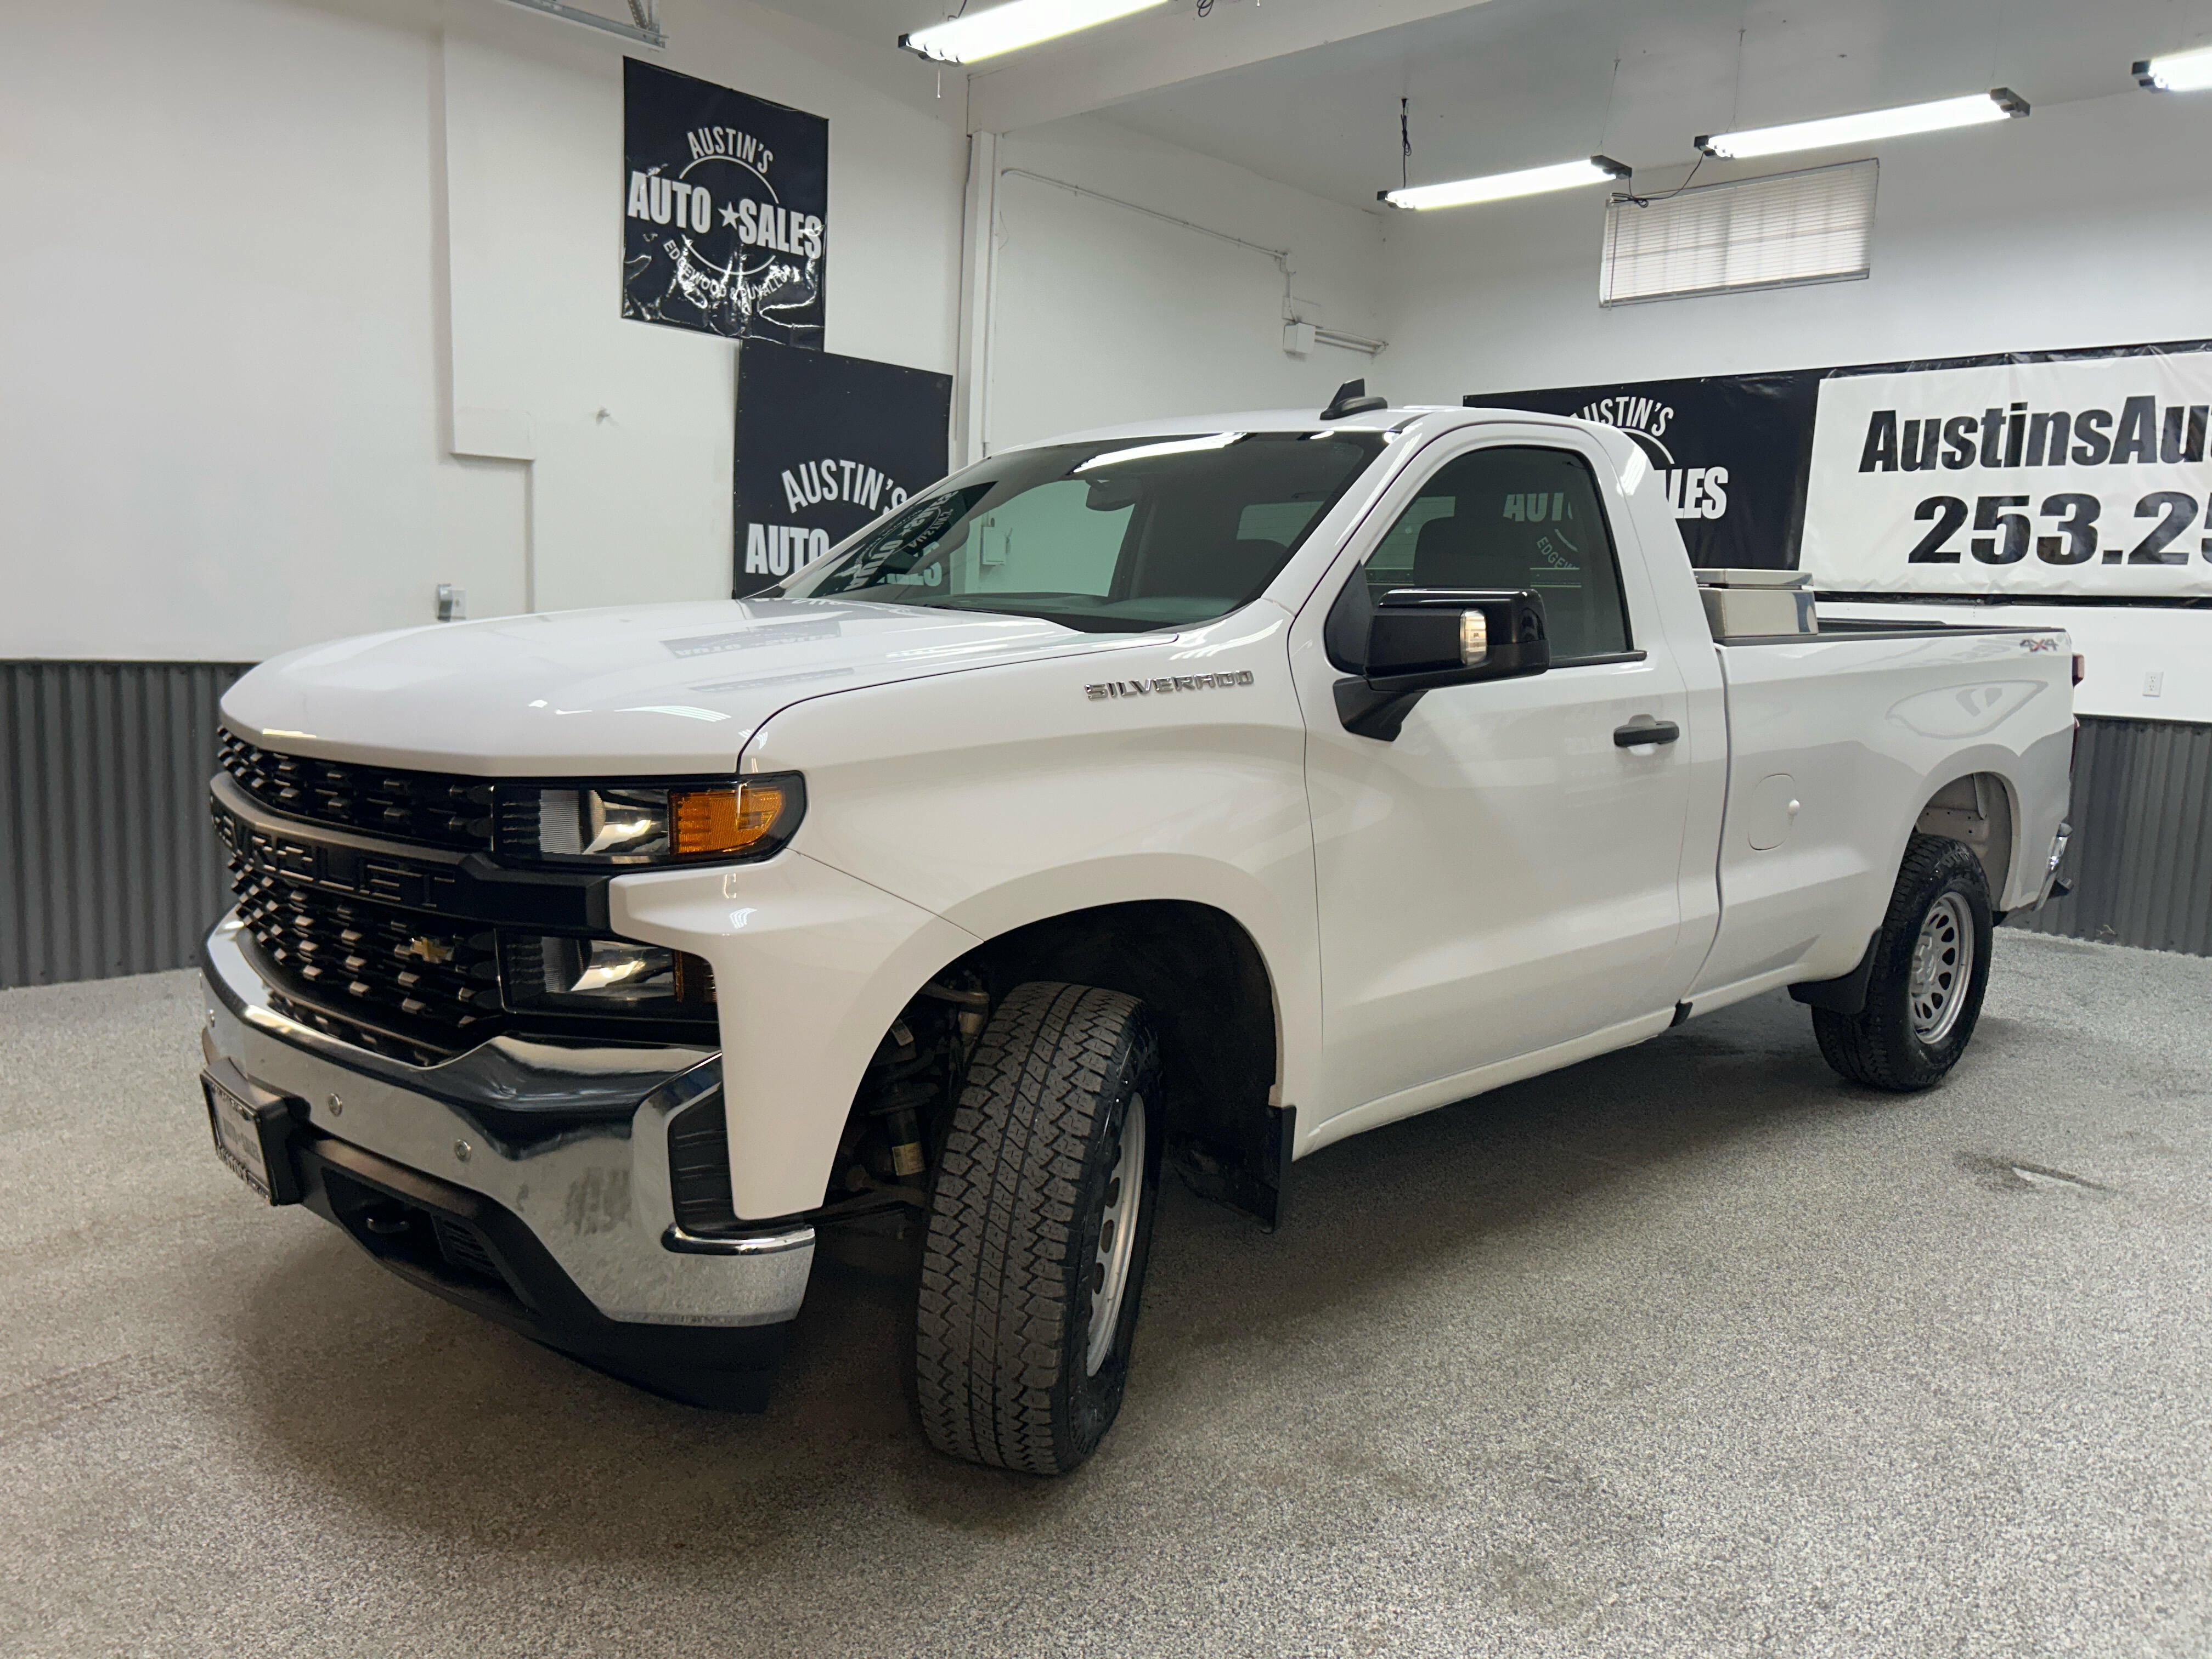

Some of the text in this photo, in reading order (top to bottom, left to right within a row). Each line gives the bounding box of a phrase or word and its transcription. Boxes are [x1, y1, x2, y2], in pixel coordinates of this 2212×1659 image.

[687, 127, 774, 174] AUSTIN'S
[628, 171, 823, 259] AUTO SALES
[663, 239, 727, 298] EDGEWOOD
[1570, 396, 1674, 437] USTIN'S
[1858, 394, 2212, 473] AustinsAu
[781, 459, 908, 514] AUSTIN'S
[1503, 492, 1573, 522] AUT
[1908, 491, 2212, 565] 253.2
[1084, 670, 1255, 700] SILVERADO
